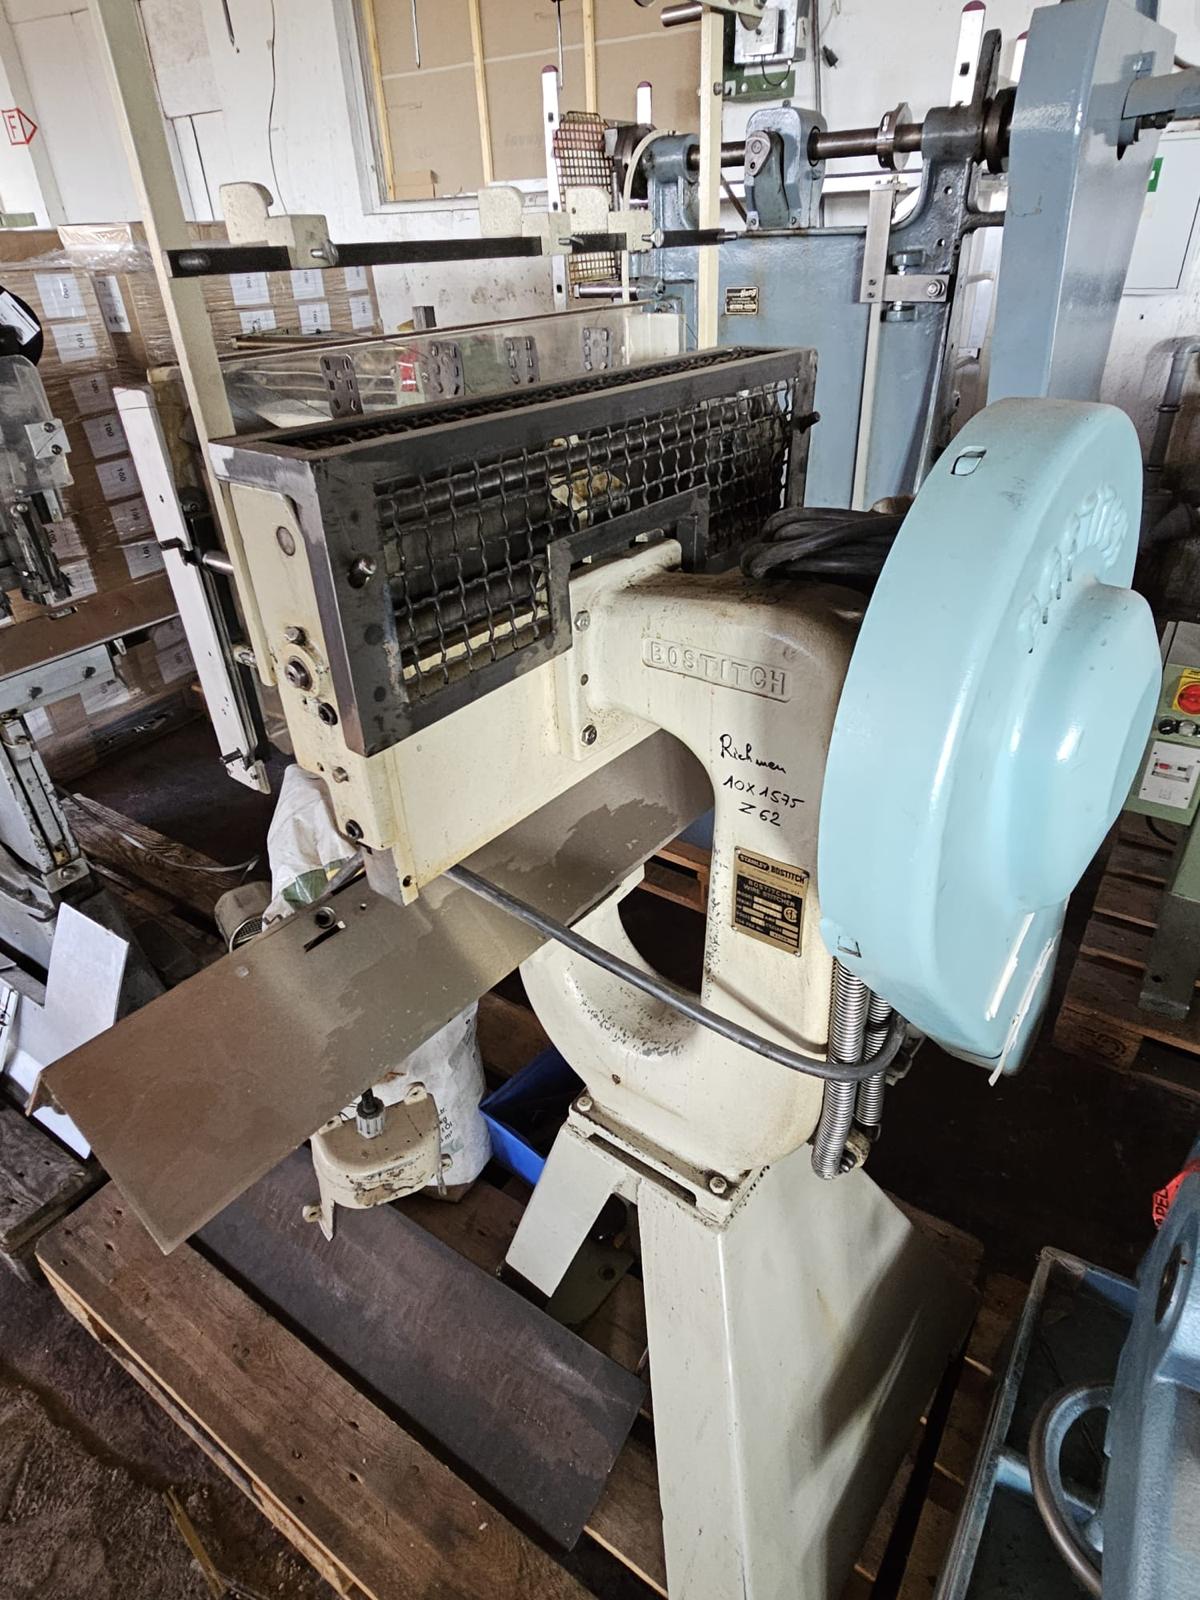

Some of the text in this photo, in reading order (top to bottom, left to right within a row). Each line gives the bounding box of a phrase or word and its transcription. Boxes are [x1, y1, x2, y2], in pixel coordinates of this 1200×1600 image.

[75, 333, 85, 349] 100
[104, 423, 115, 438] 100
[117, 468, 127, 482] 100
[650, 641, 786, 696] BOSTITCH
[760, 809, 781, 827] 62
[770, 865, 806, 884] BOSTITCH
